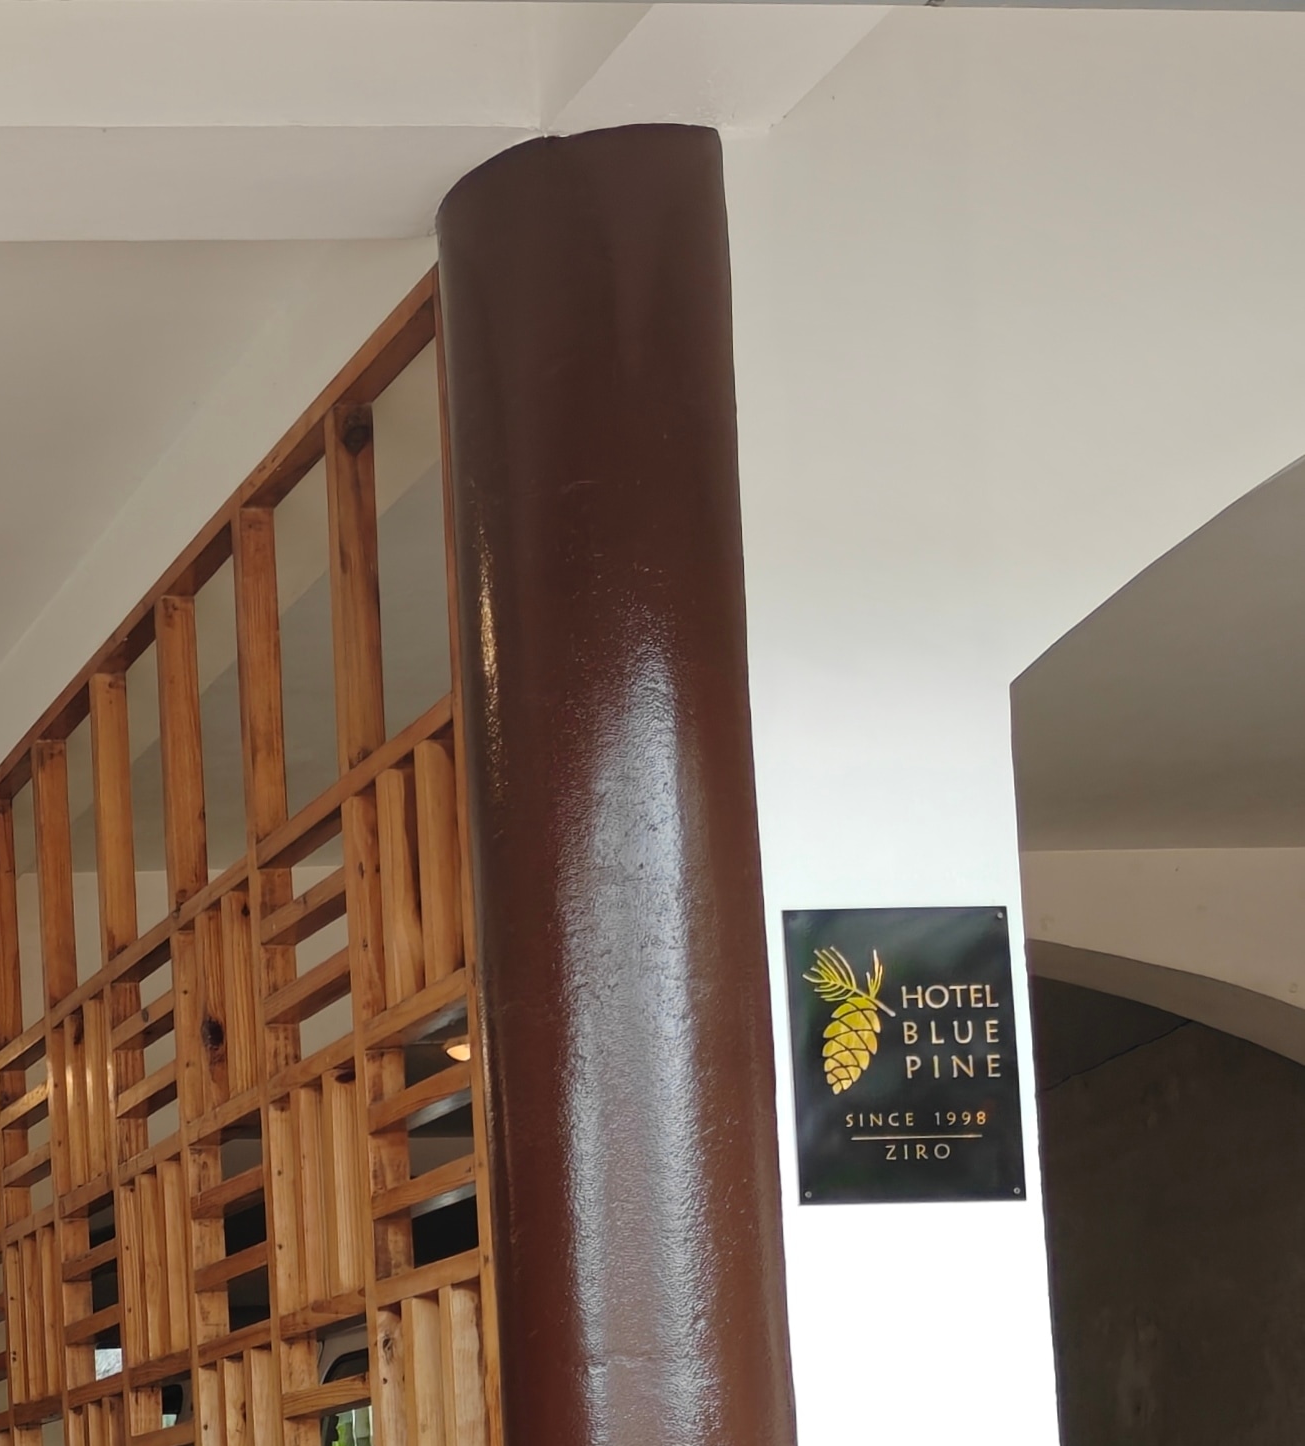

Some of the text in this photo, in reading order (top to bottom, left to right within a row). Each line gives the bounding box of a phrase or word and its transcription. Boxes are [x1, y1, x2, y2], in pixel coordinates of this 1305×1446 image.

[901, 984, 1000, 1009] HOTEL
[902, 1019, 1000, 1045] BLUE
[905, 1053, 1001, 1079] PINE
[845, 1110, 987, 1128] SINCE 1998
[885, 1143, 951, 1161] ZIRO
